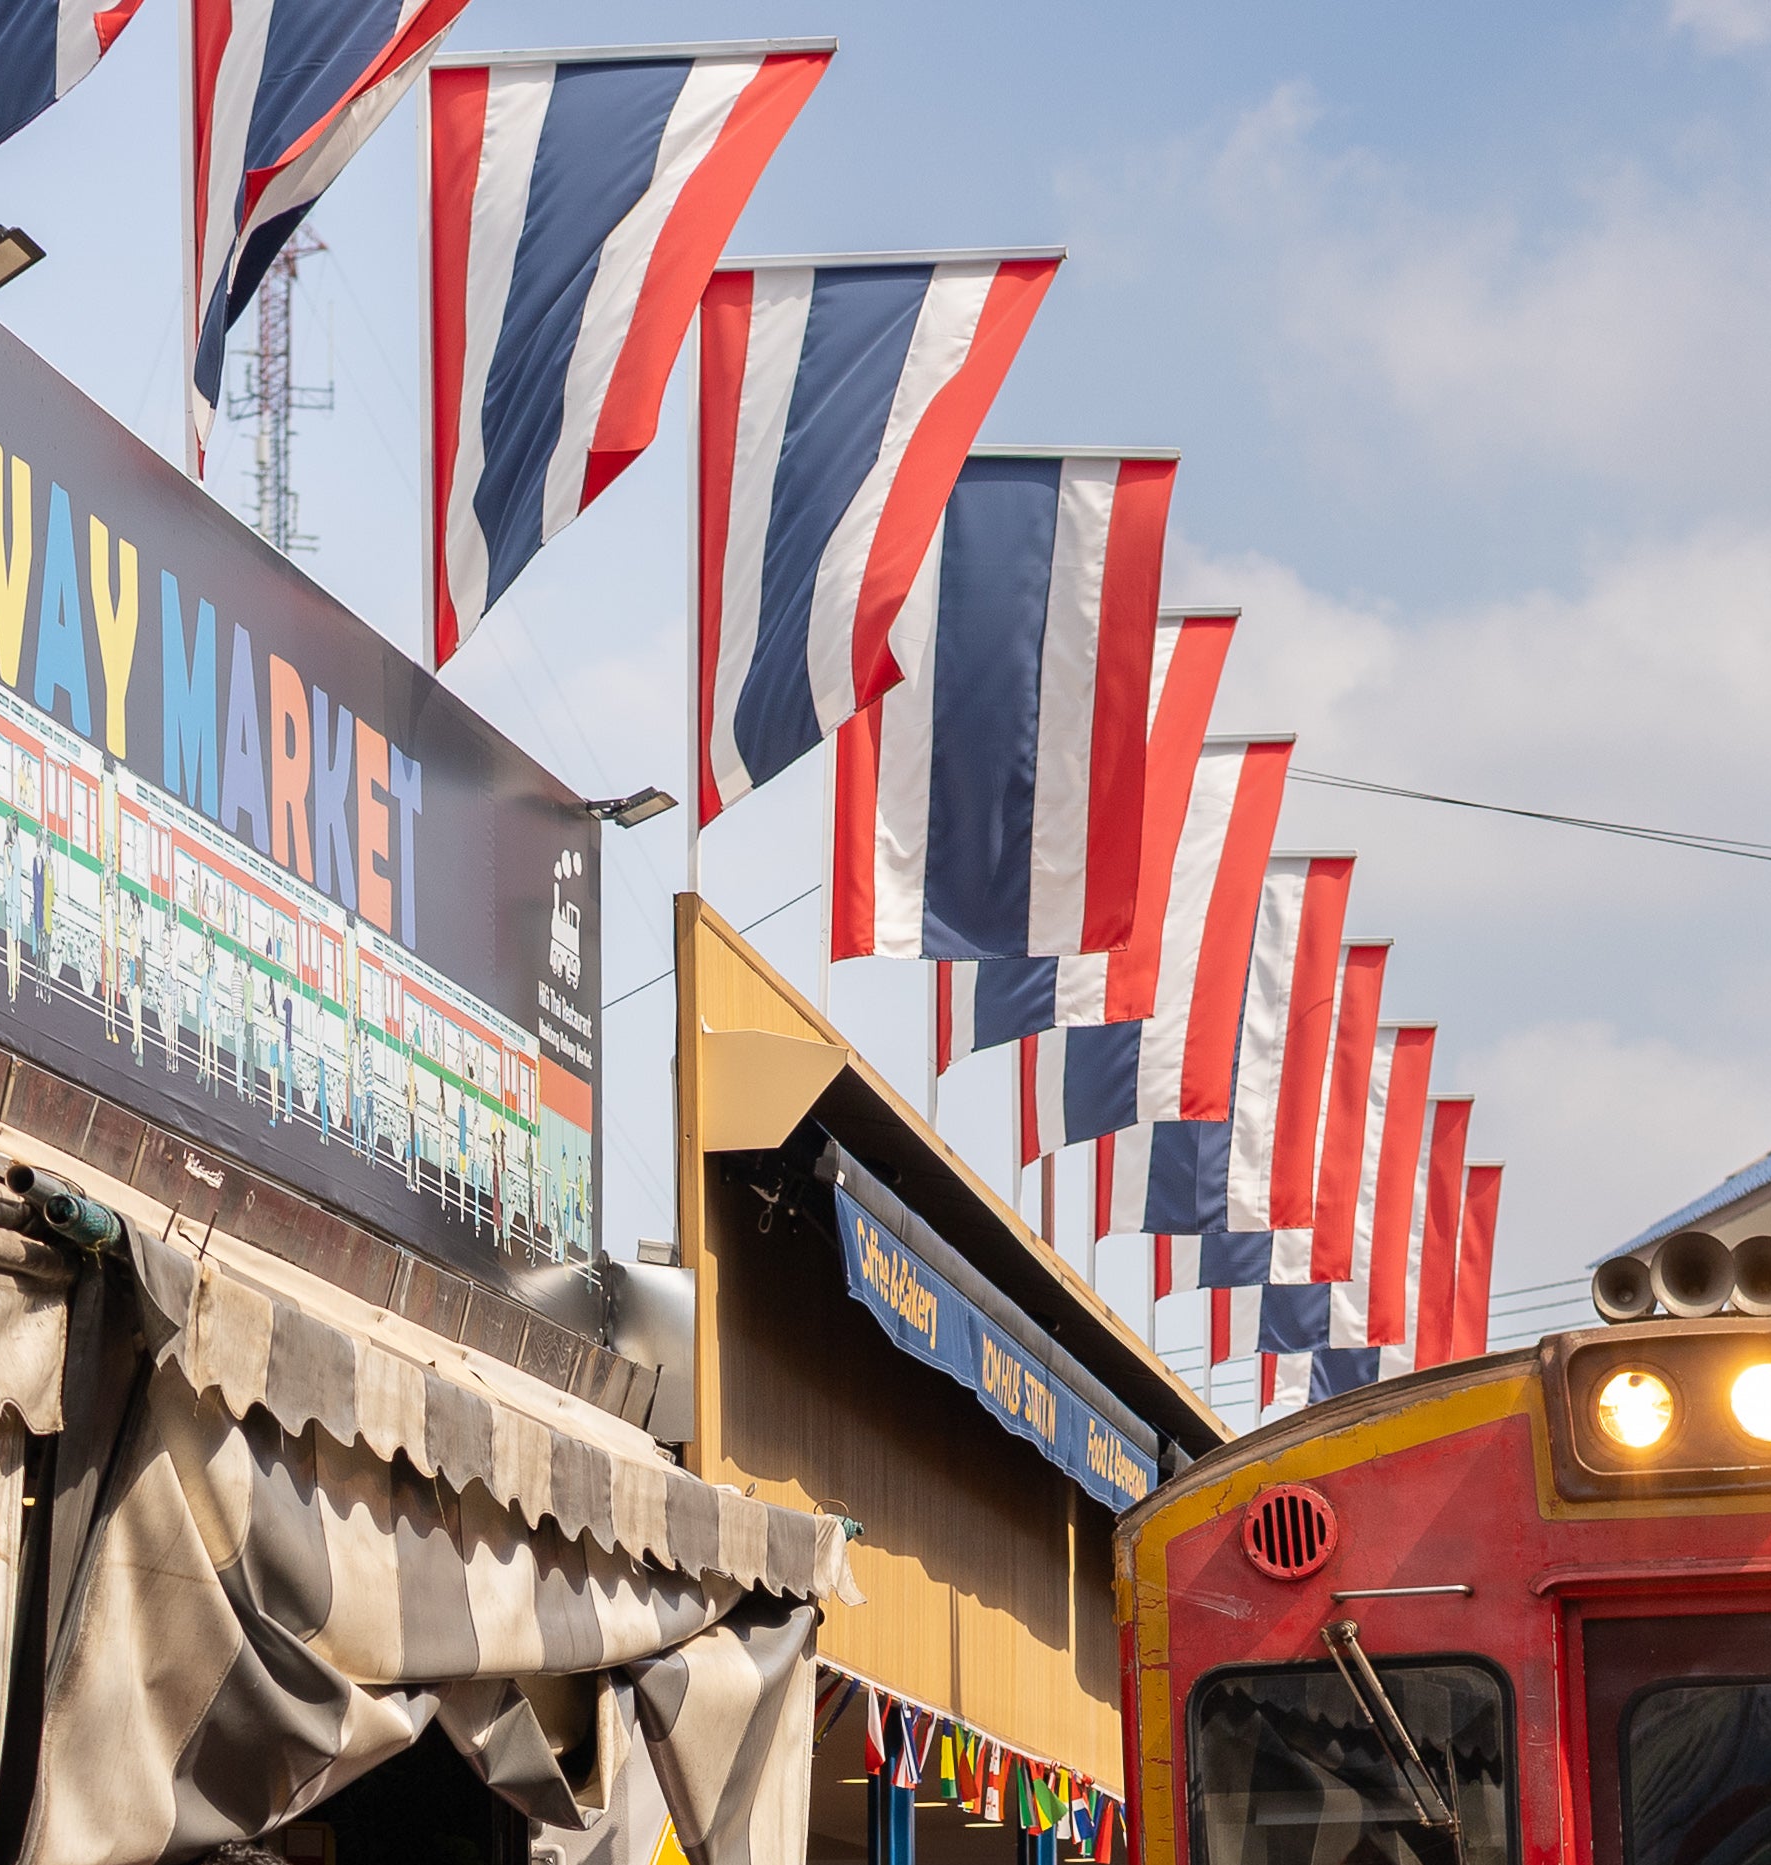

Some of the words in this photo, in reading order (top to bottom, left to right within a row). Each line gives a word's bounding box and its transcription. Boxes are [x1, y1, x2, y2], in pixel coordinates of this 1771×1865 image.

[162, 569, 423, 950] MARKET
[562, 996, 593, 1039] Restaurant
[856, 1217, 890, 1303] Coffee
[890, 1250, 899, 1309] &
[899, 1257, 938, 1350] Bakery
[1086, 1417, 1108, 1479] Food
